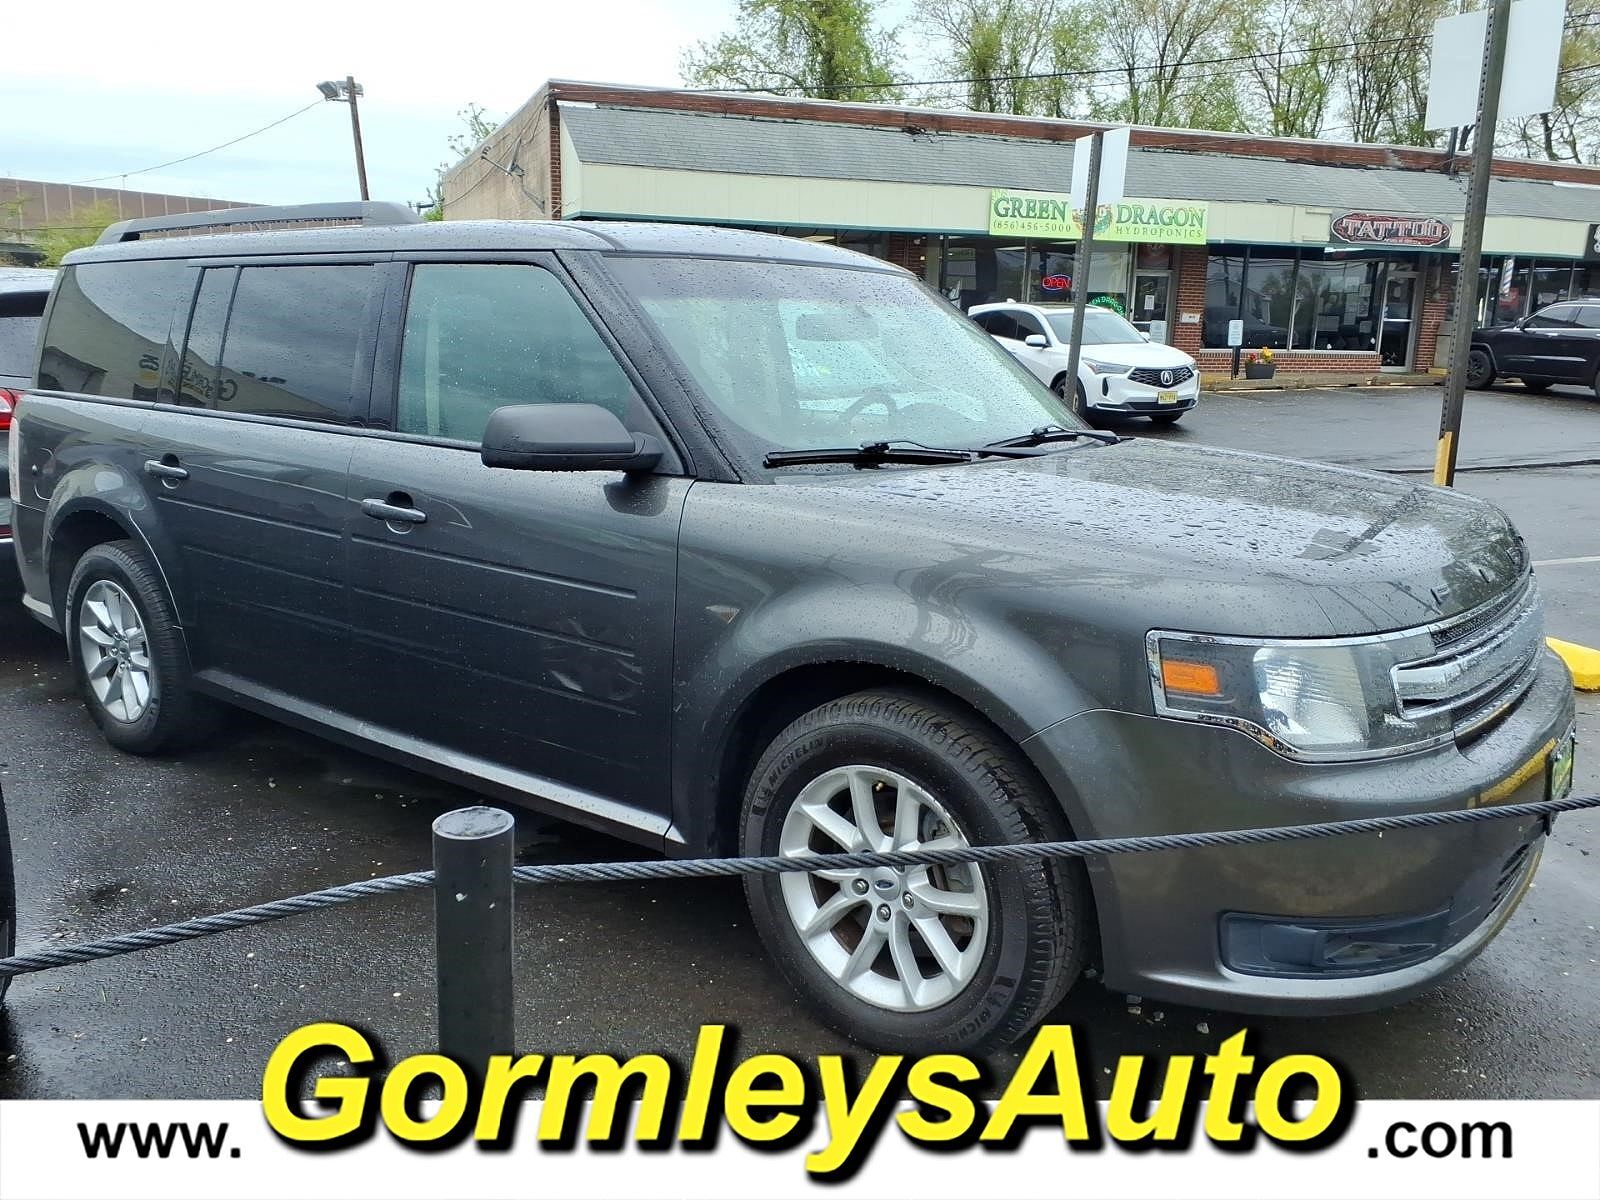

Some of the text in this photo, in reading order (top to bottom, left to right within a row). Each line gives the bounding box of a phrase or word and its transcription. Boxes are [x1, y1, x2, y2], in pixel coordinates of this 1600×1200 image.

[993, 196, 1206, 229] GREEN DRAGON
[993, 220, 1072, 233] (856)456-5000
[1343, 218, 1443, 239] TATTOO
[1044, 277, 1072, 289] OPEN
